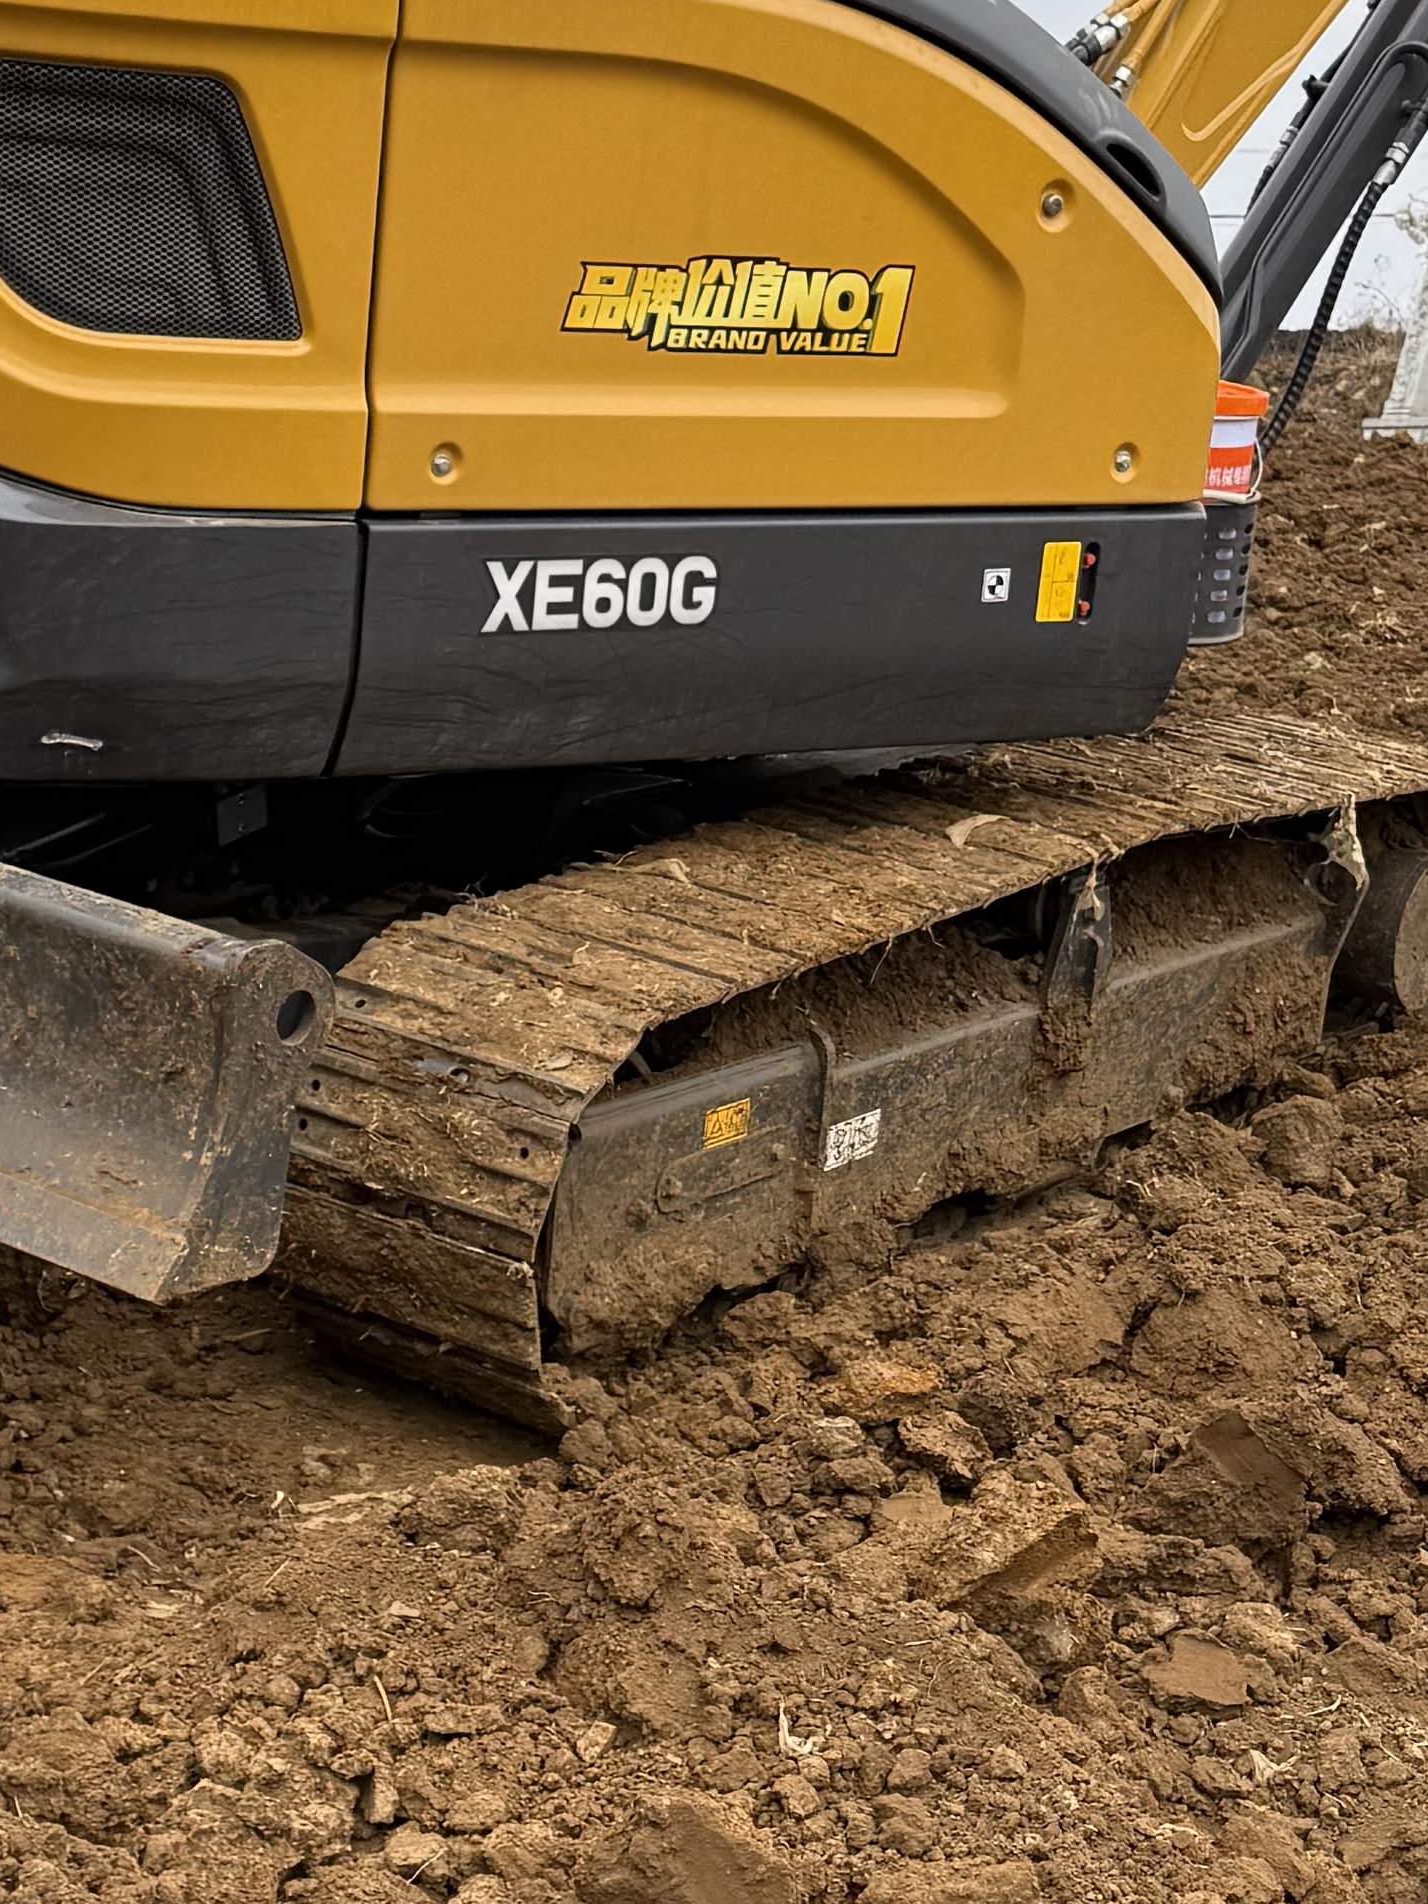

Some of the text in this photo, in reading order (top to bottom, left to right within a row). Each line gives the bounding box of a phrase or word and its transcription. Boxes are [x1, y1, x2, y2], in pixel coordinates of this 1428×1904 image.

[667, 329, 868, 353] BRAND VALUE
[480, 555, 718, 633] XE60G
